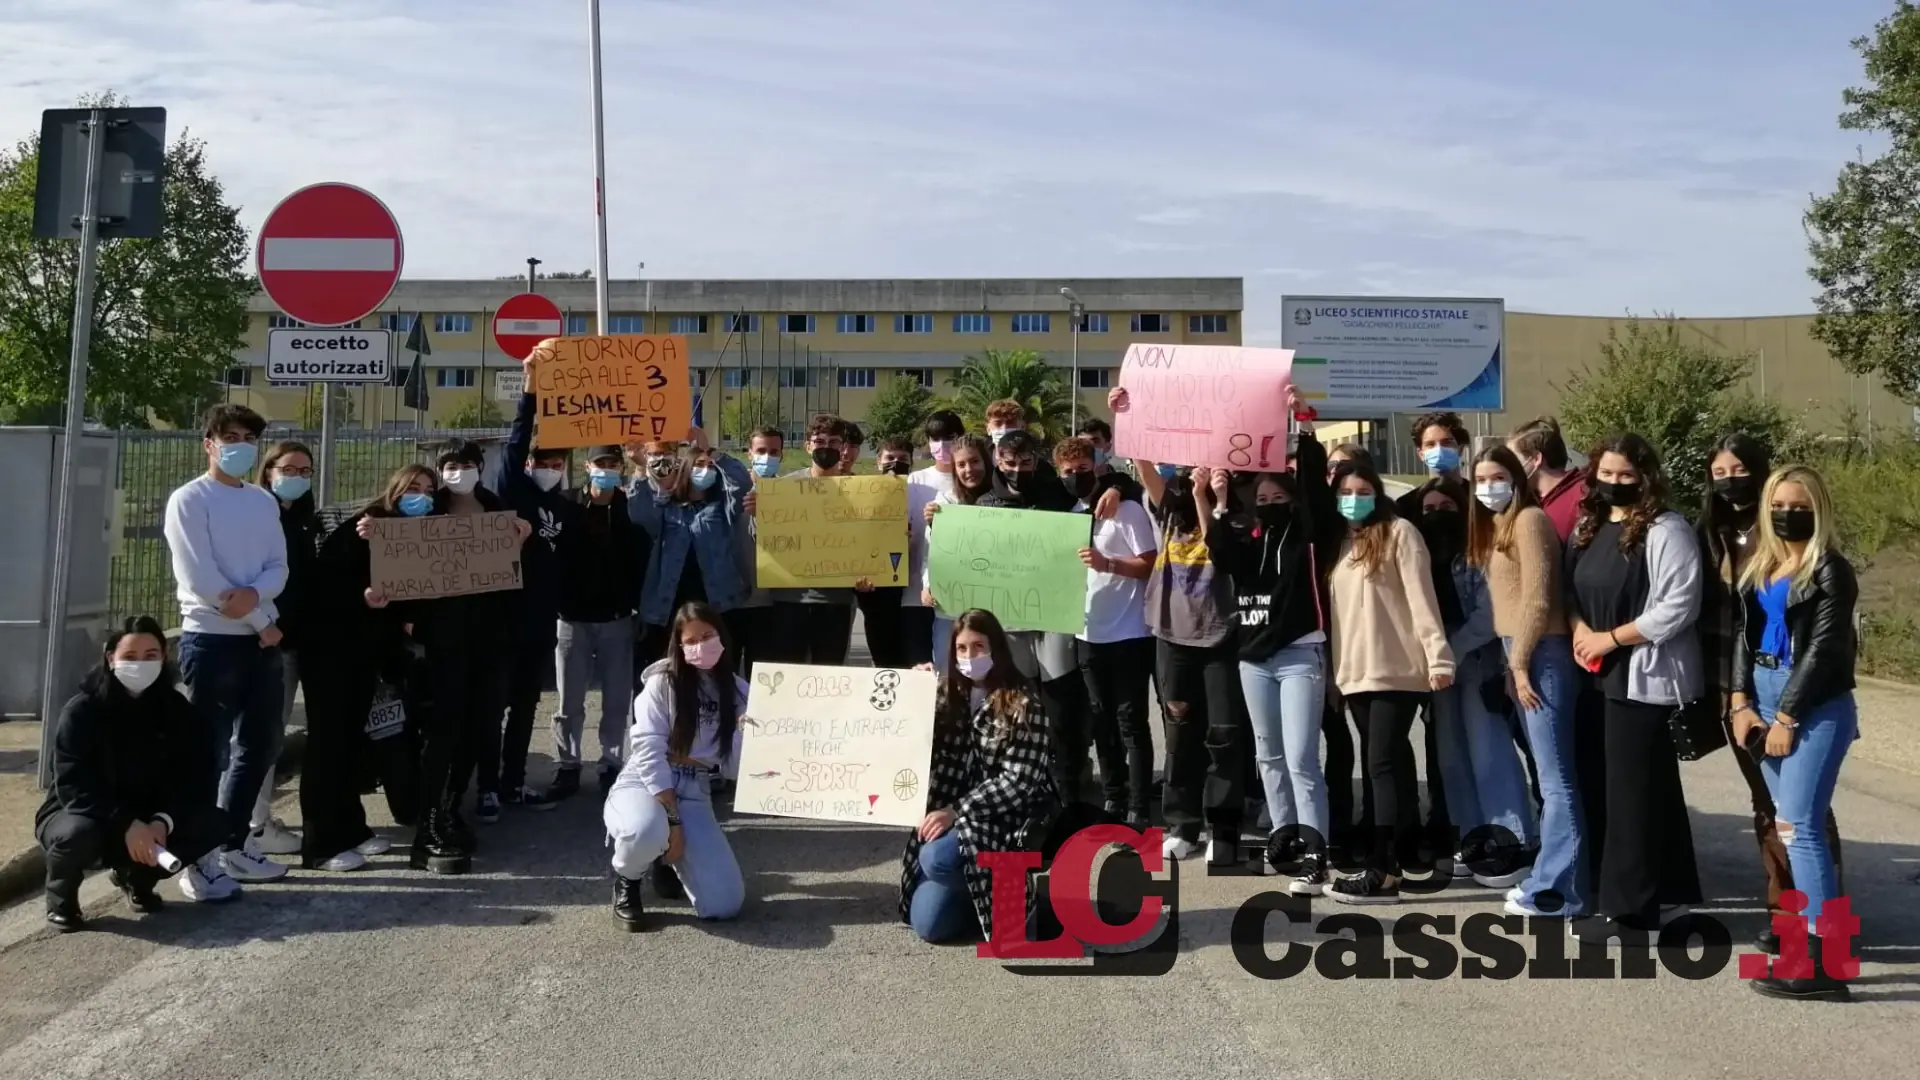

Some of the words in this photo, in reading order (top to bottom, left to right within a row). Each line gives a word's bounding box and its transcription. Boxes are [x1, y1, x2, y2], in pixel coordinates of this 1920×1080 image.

[1315, 307, 1348, 318] LICEO
[1350, 308, 1420, 319] SCIENTIFICO
[1422, 309, 1469, 320] STATALE
[290, 335, 370, 350] eccetto
[572, 338, 655, 364] TORNO
[662, 338, 677, 362] A
[273, 360, 384, 375] autorizzati
[1126, 345, 1176, 369] NON
[538, 366, 594, 391] CASA
[598, 364, 638, 388] ALLE
[644, 365, 668, 390] 3
[542, 393, 628, 417] L'ESAME
[637, 392, 666, 413] LO
[480, 514, 510, 532] HO
[760, 506, 809, 524] DELLA
[383, 537, 514, 559] APPUNTAMENTO
[763, 534, 801, 552] NON
[429, 558, 468, 574] CON
[381, 577, 436, 598] MARIA
[443, 575, 462, 590] DE
[796, 675, 853, 700] ALLE
[829, 717, 910, 740] ENTRARE
[759, 794, 824, 815] VOGLIAMO
